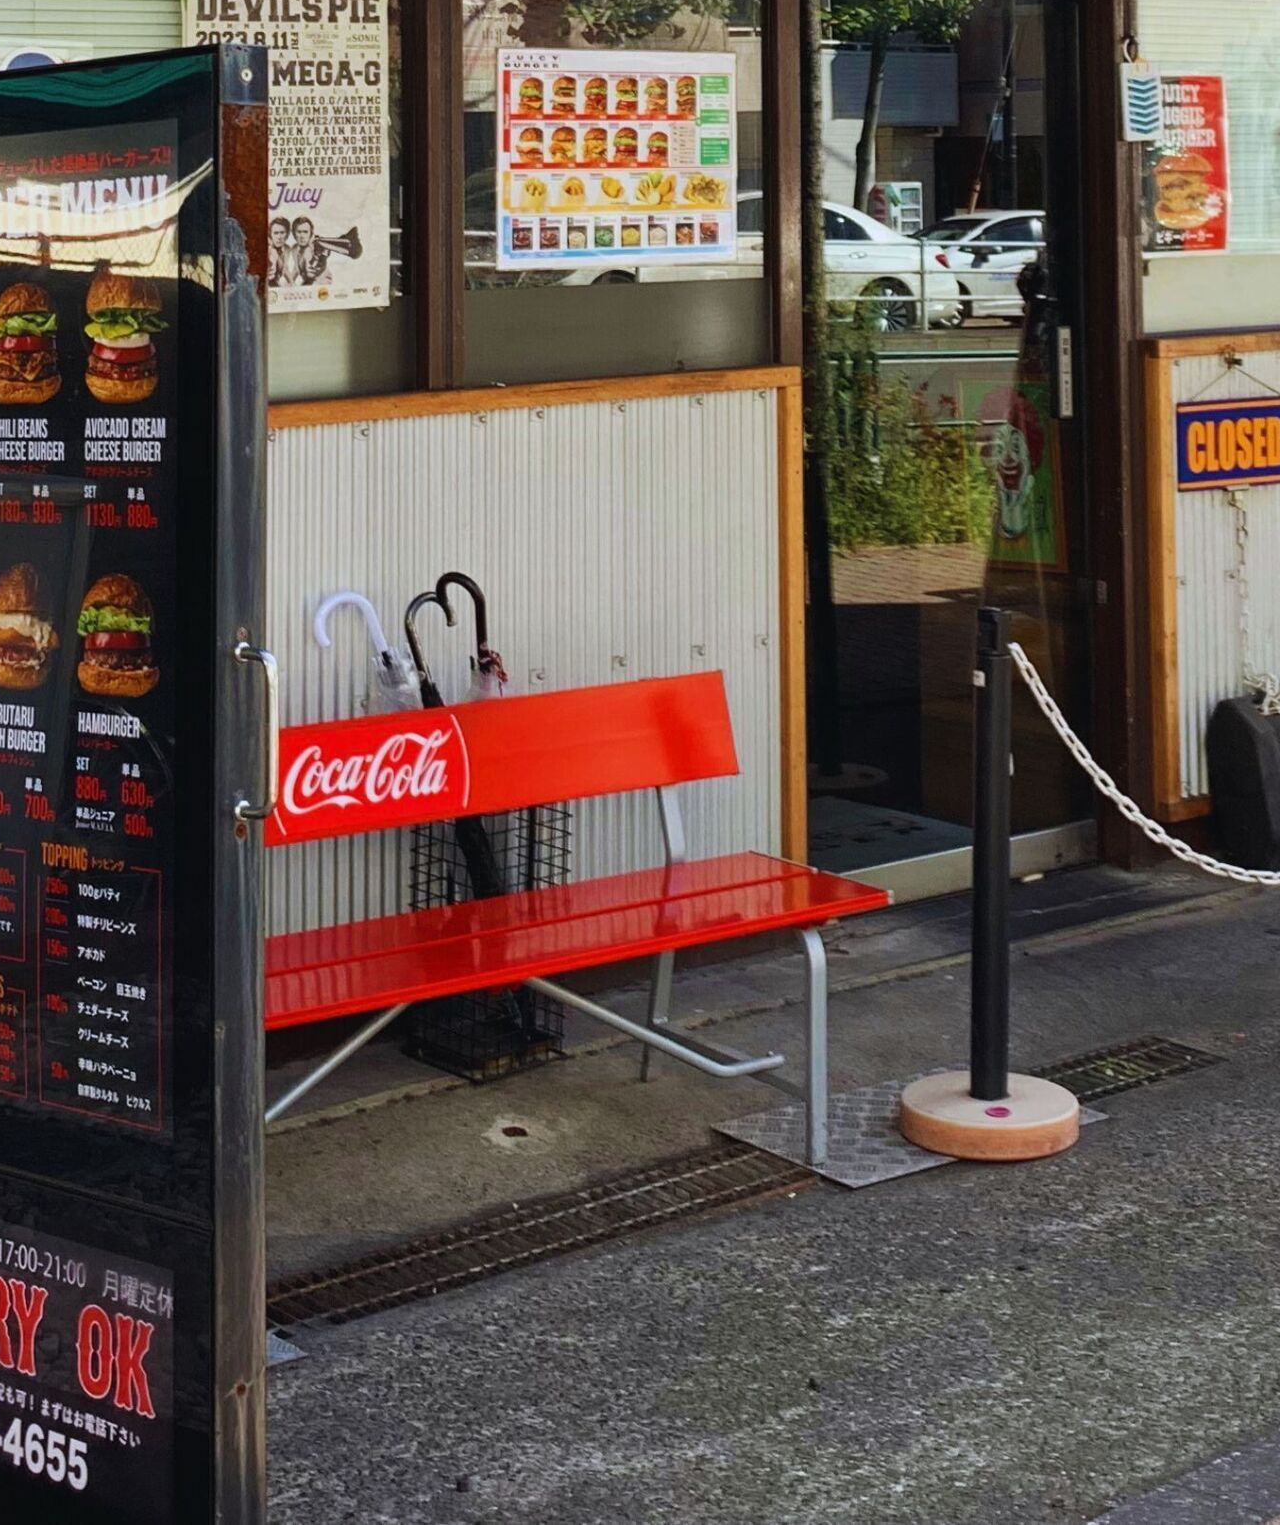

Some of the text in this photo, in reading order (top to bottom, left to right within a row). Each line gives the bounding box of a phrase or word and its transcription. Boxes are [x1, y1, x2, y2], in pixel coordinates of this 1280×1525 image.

[196, 31, 289, 51] 20238.11
[272, 60, 381, 87] MEGA-G
[268, 182, 323, 211] Juicy
[18, 418, 48, 439] BEANS
[85, 418, 166, 439] AVOCADO CREAM
[28, 441, 65, 462] BURGER
[85, 441, 161, 462] CHEESE BURGER
[84, 485, 97, 499] SET
[78, 711, 140, 739] HAMBURGER
[8, 728, 46, 753] BURGER
[76, 756, 90, 771] SET
[283, 729, 453, 815] Coca-Cola
[41, 842, 89, 871] TOPPING
[102, 1269, 174, 1319] 月曜定休
[76, 1304, 156, 1419] OK
